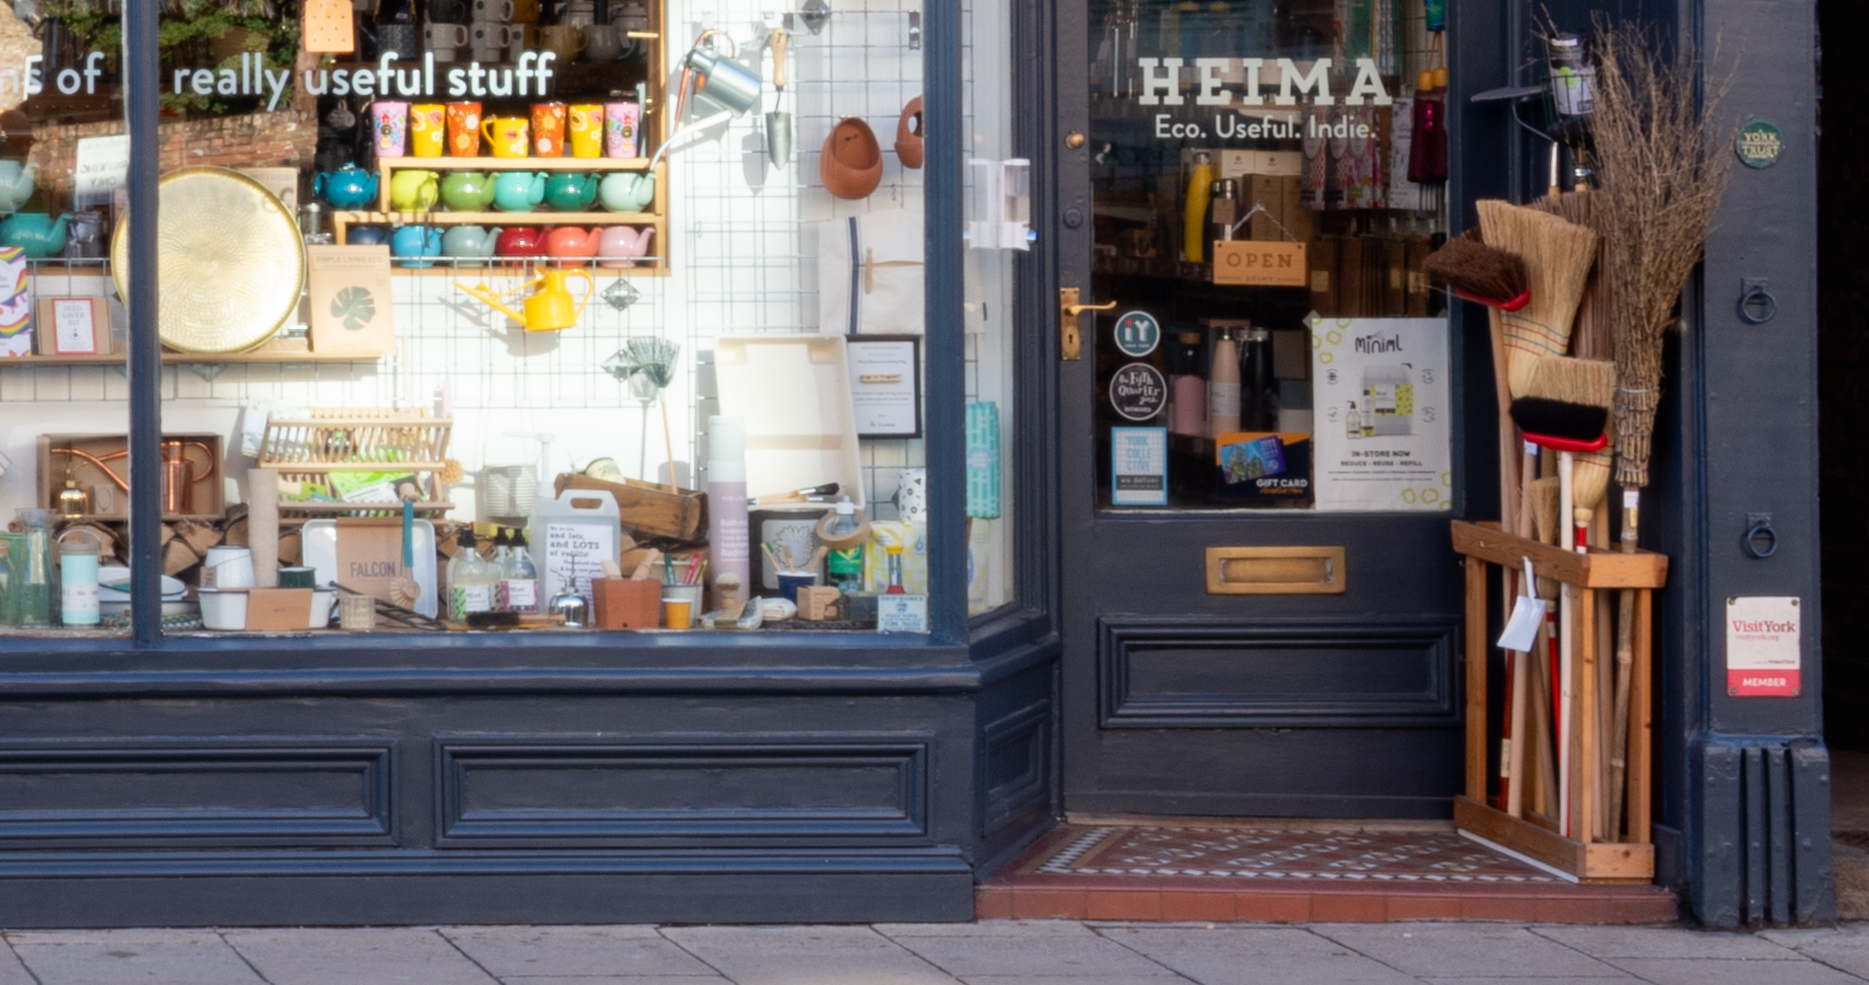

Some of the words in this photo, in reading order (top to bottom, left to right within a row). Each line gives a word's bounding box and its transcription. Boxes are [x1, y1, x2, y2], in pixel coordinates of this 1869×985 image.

[56, 51, 106, 96] of
[173, 52, 290, 111] really
[305, 51, 434, 96] useful
[448, 51, 555, 96] stuff
[1138, 57, 1393, 105] HEIMA
[1155, 114, 1207, 139] Eco.
[1215, 114, 1301, 139] Useful.
[1310, 114, 1377, 139] Indie.
[1742, 145, 1778, 155] TRUST
[1226, 252, 1293, 268] OPEN
[1256, 479, 1279, 487] GIFT
[1280, 479, 1308, 487] CARD
[573, 541, 600, 550] LOTS
[350, 561, 395, 577] FALCON
[1743, 677, 1786, 687] MEMBER
